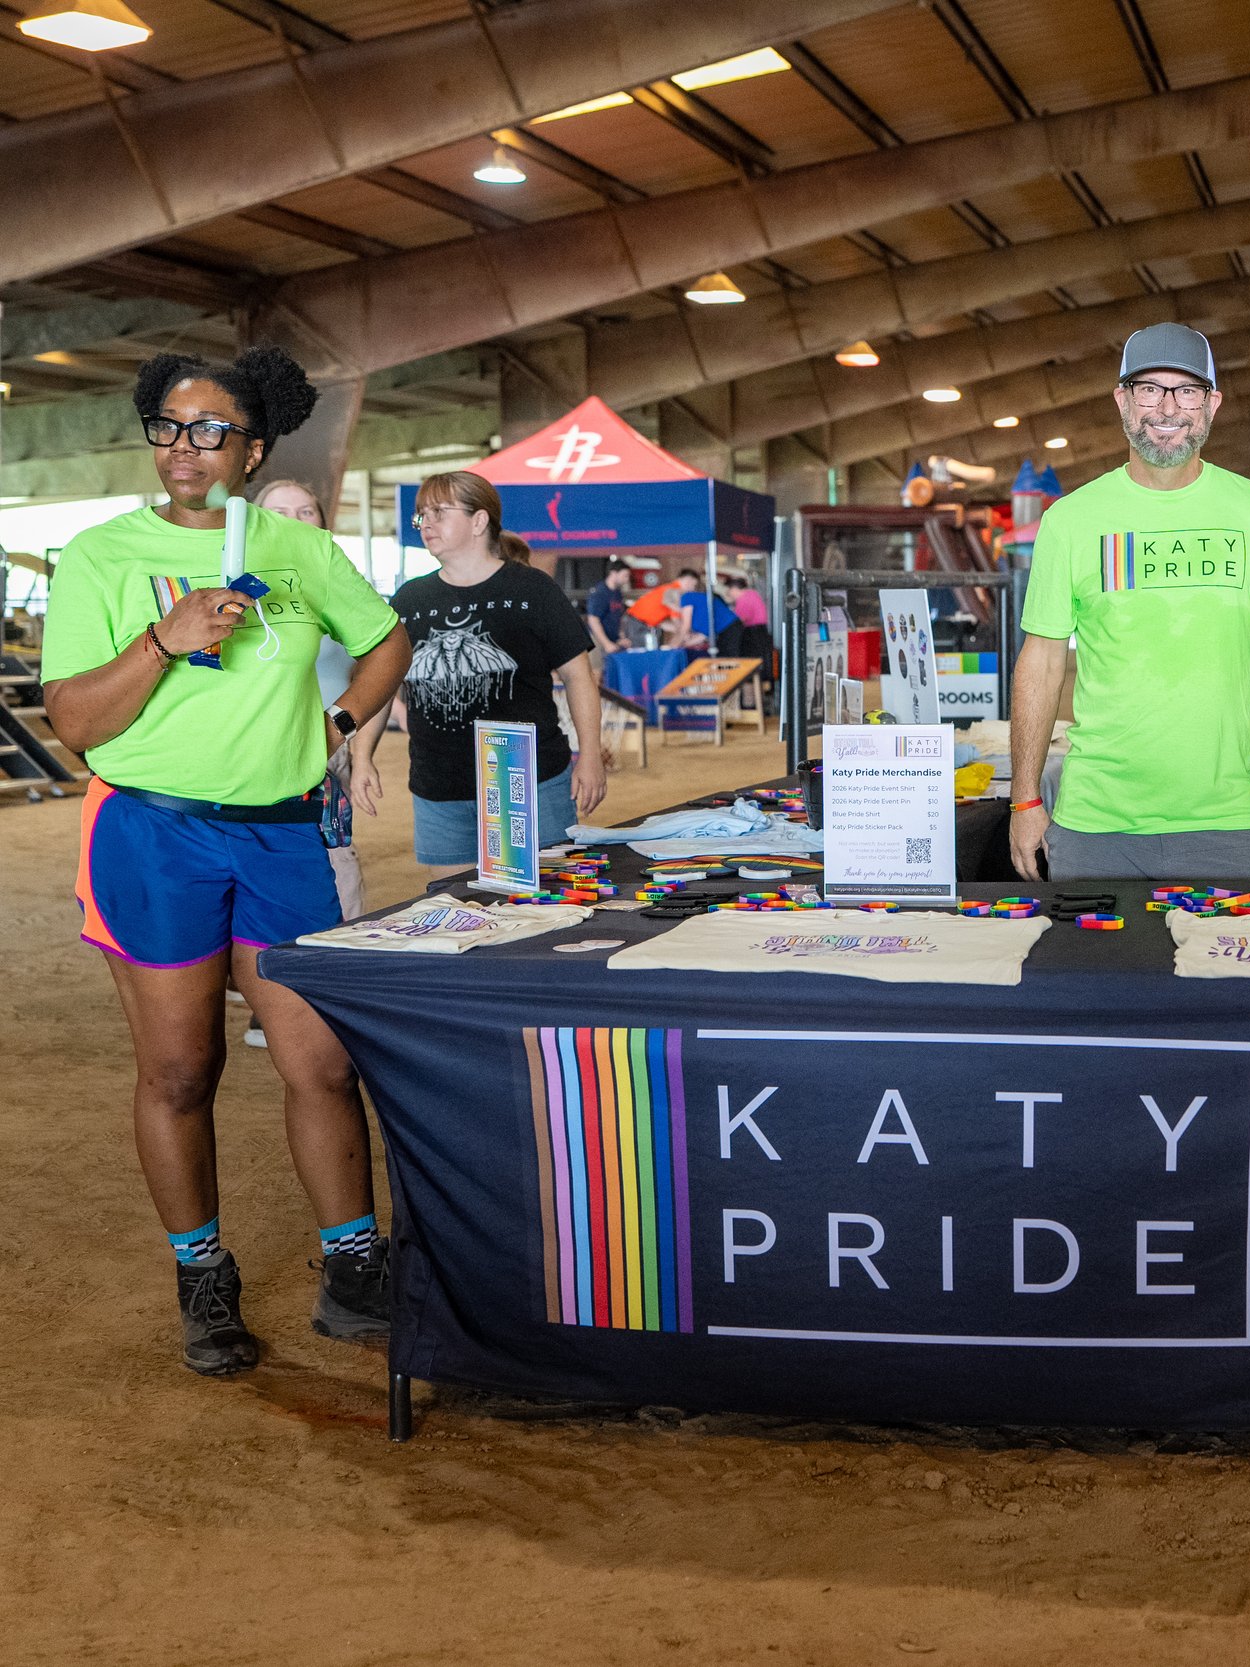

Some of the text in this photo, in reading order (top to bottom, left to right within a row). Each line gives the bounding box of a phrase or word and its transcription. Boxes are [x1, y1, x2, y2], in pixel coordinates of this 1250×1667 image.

[1143, 538, 1237, 555] KATY
[1144, 560, 1237, 579] PRIDE
[832, 768, 942, 778] Katy Pride Merchandise
[848, 785, 863, 793] Katy
[927, 785, 939, 793] $22
[848, 798, 862, 806] Katy
[832, 824, 847, 832] Katy
[717, 1084, 1208, 1172] KATY
[722, 1208, 1196, 1295] PRIDE
